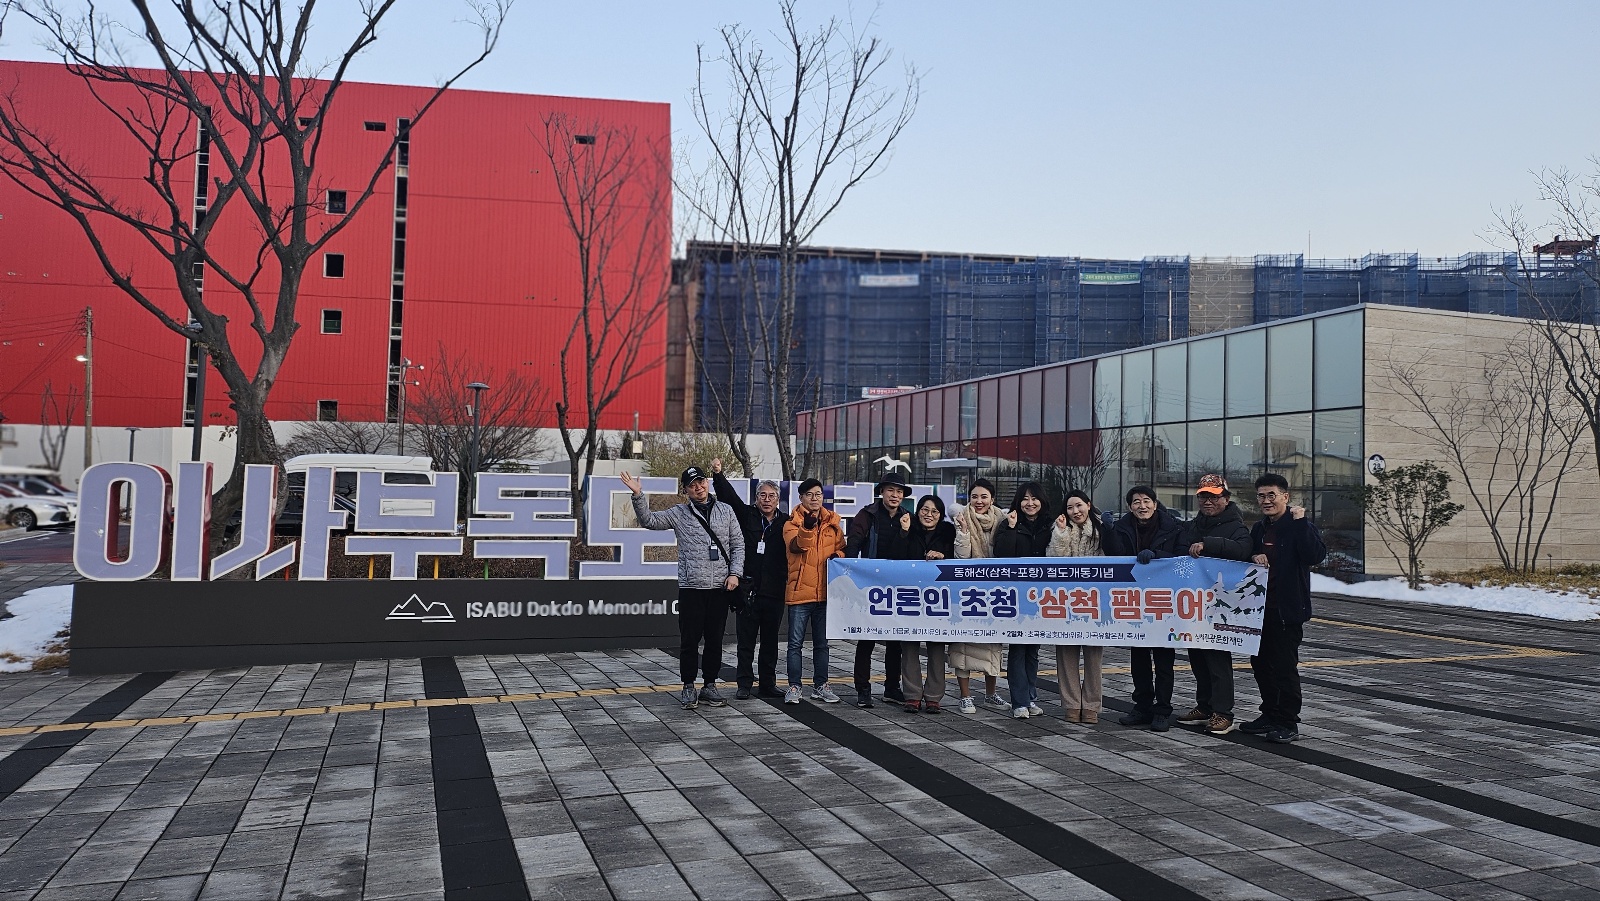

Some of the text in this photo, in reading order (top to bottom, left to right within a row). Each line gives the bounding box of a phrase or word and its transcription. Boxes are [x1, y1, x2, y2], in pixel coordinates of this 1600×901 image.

[953, 567, 1044, 579] 동해선(삼척~포항)
[466, 601, 522, 618] ISABU
[527, 600, 583, 617] Dokdo
[588, 599, 667, 616] Memorial
[868, 587, 950, 617] 언론인
[961, 588, 1017, 618] 초청
